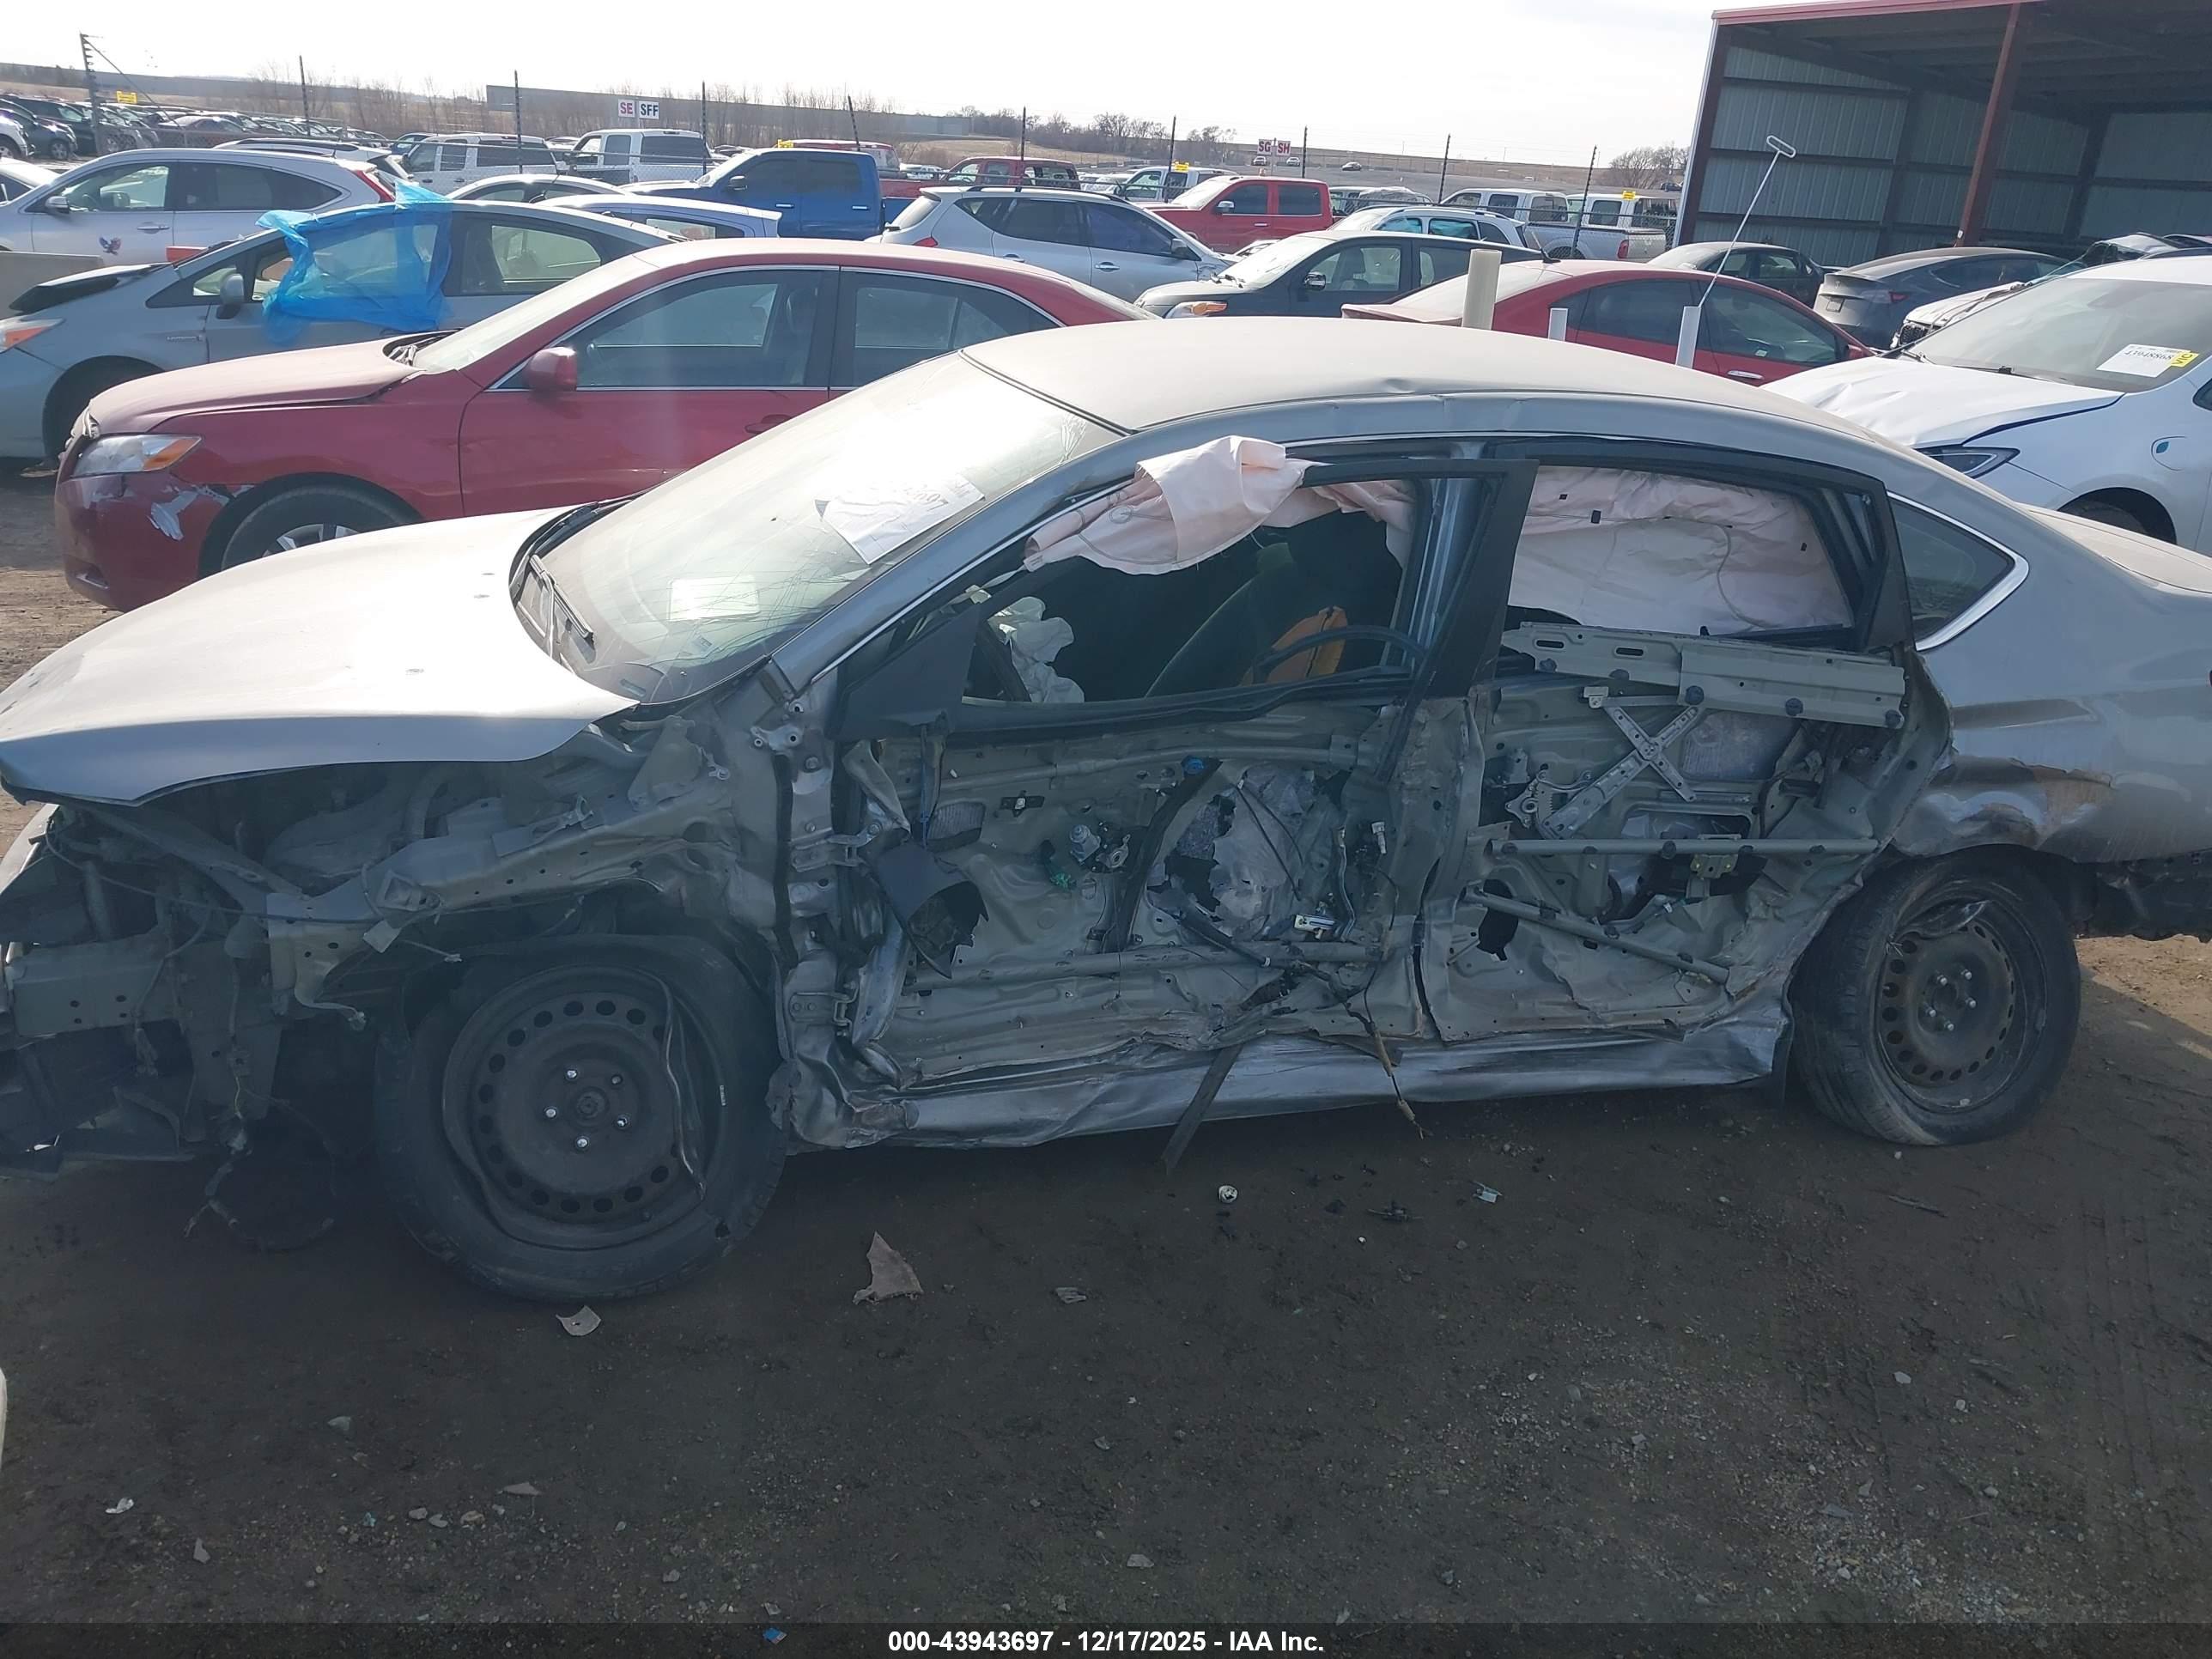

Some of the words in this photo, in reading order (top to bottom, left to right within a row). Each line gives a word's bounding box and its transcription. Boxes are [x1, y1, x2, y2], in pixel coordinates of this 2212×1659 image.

[620, 102, 633, 114] SE
[640, 103, 659, 116] SFF
[1258, 141, 1271, 152] SG
[1277, 143, 1290, 154] SH
[2171, 353, 2193, 365] VIC
